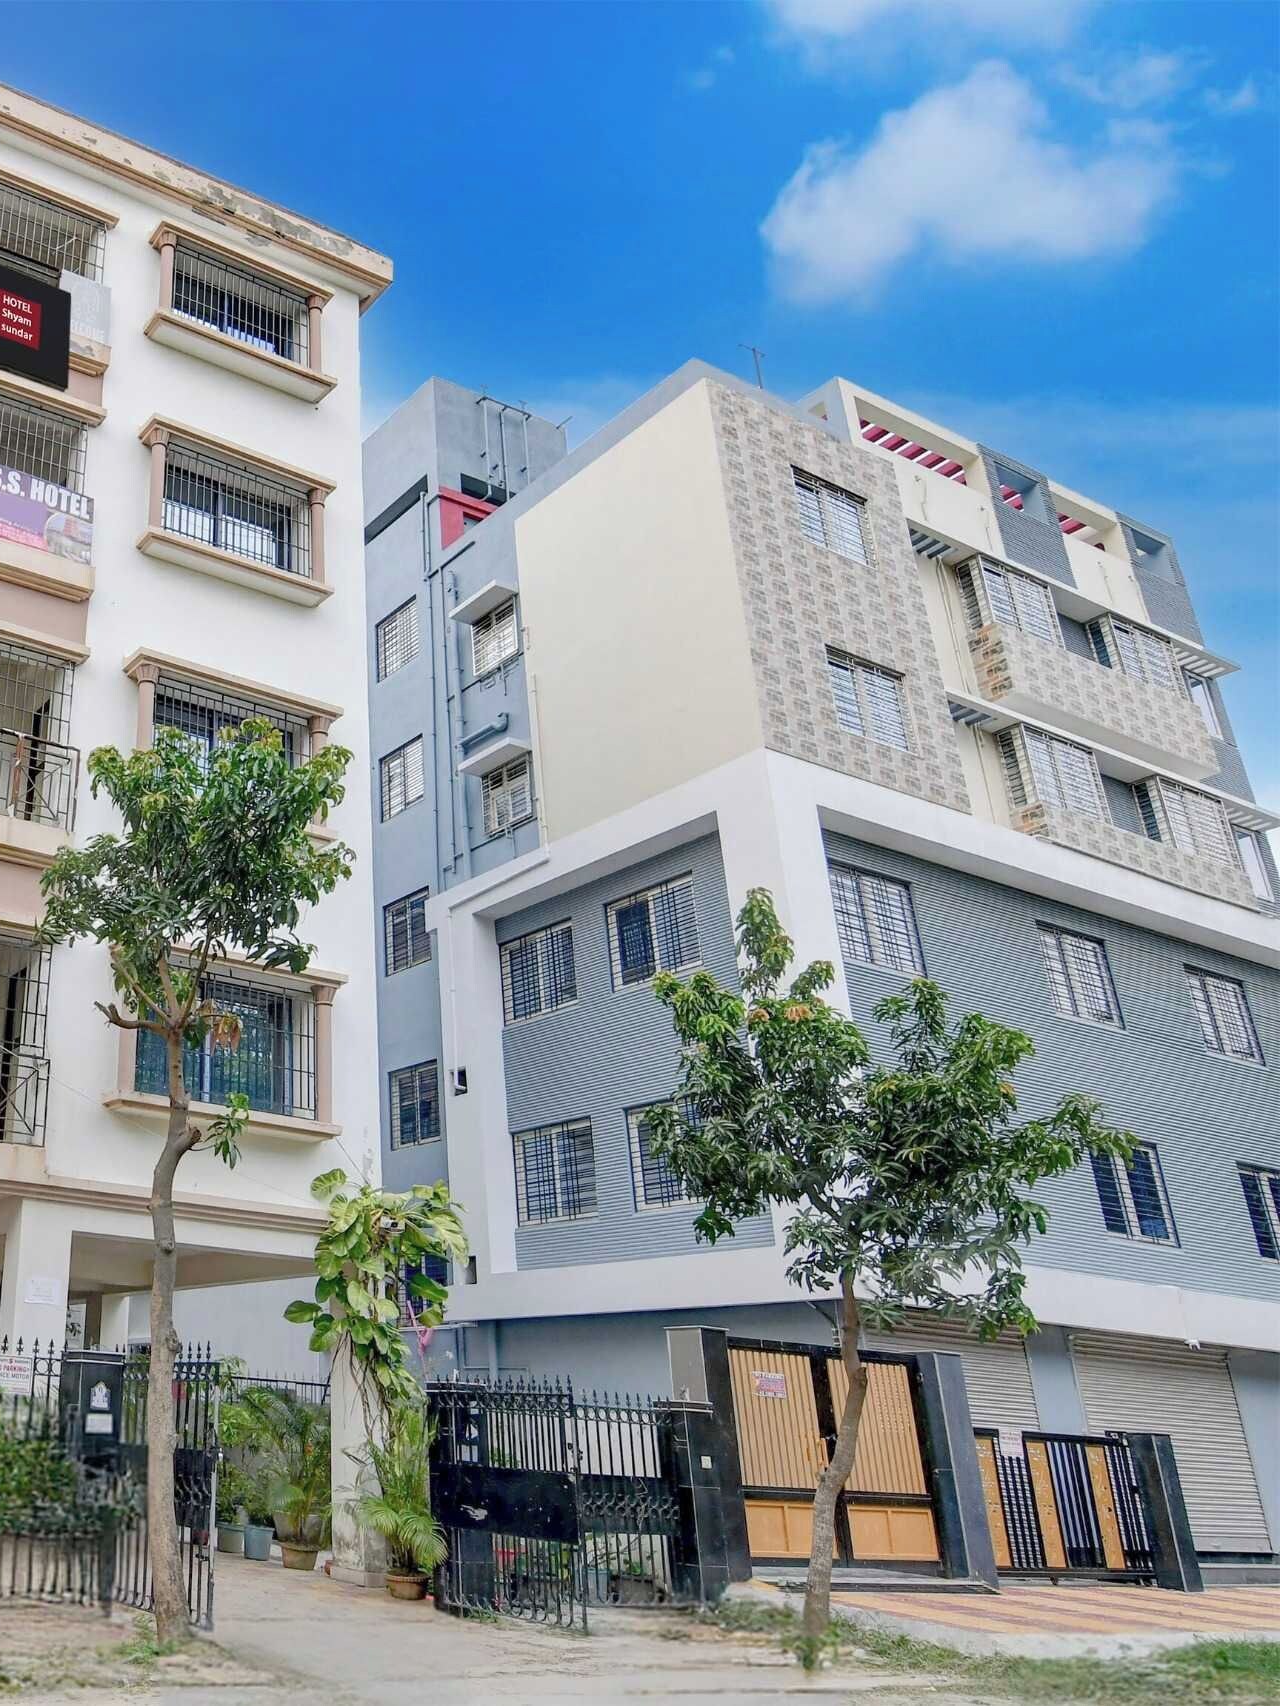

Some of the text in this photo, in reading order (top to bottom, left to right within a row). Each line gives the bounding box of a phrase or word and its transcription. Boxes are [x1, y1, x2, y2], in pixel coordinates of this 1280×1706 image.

[3, 294, 32, 314] HOTEL
[1, 308, 32, 327] Shyam
[1, 323, 33, 341] sundar
[30, 477, 90, 520] HOTEL
[3, 1364, 26, 1372] PARKING
[11, 1372, 30, 1380] MOTOR
